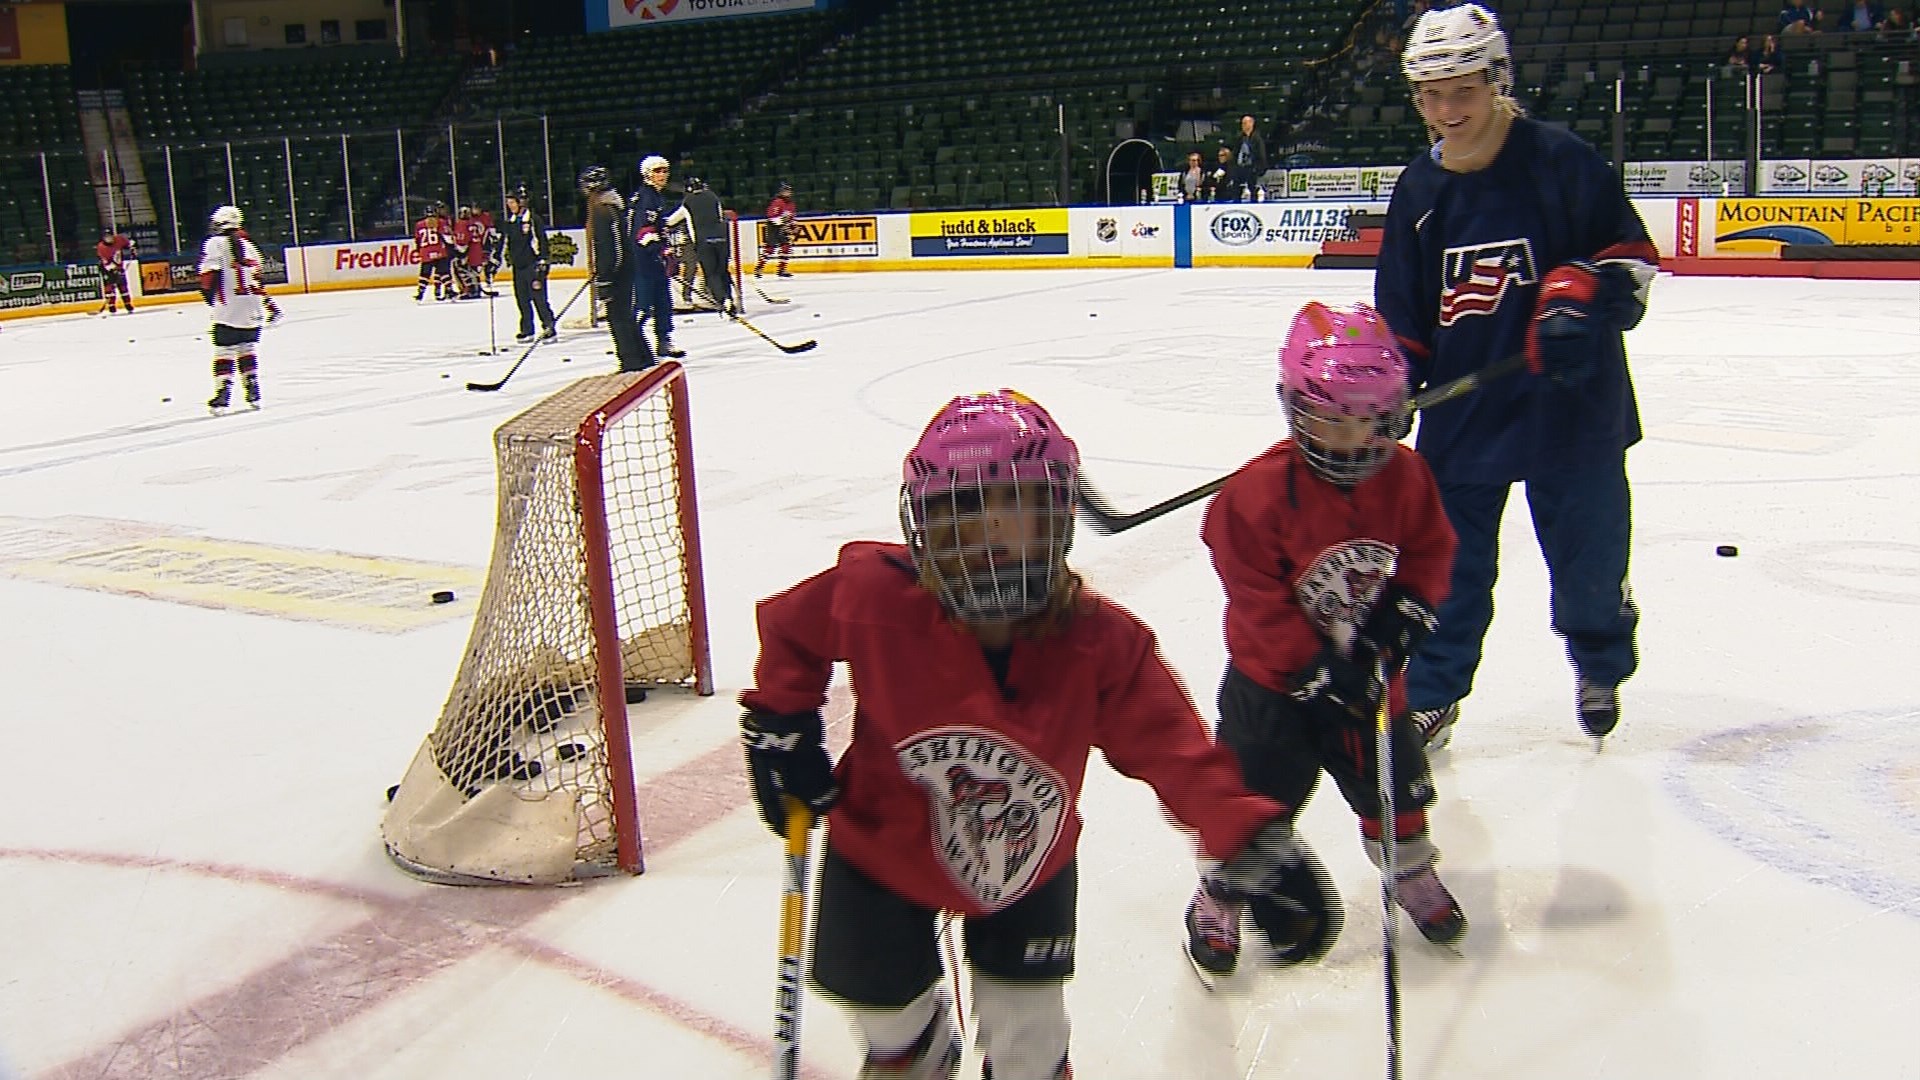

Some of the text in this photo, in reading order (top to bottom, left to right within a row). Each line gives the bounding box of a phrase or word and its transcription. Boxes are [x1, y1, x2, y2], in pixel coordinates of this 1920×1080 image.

[1719, 202, 1920, 222] MOUNTAIN PACIF
[762, 222, 873, 243] AVITT
[941, 218, 1036, 236] judd & black
[1221, 217, 1251, 231] FOX
[418, 228, 439, 247] 26
[1221, 231, 1252, 239] SPORTS
[336, 246, 421, 270] FredMe
[1441, 238, 1538, 327] USA
[948, 444, 993, 461] Reebok
[1299, 545, 1389, 607] WASHING
[911, 736, 1060, 813] SHINGTON
